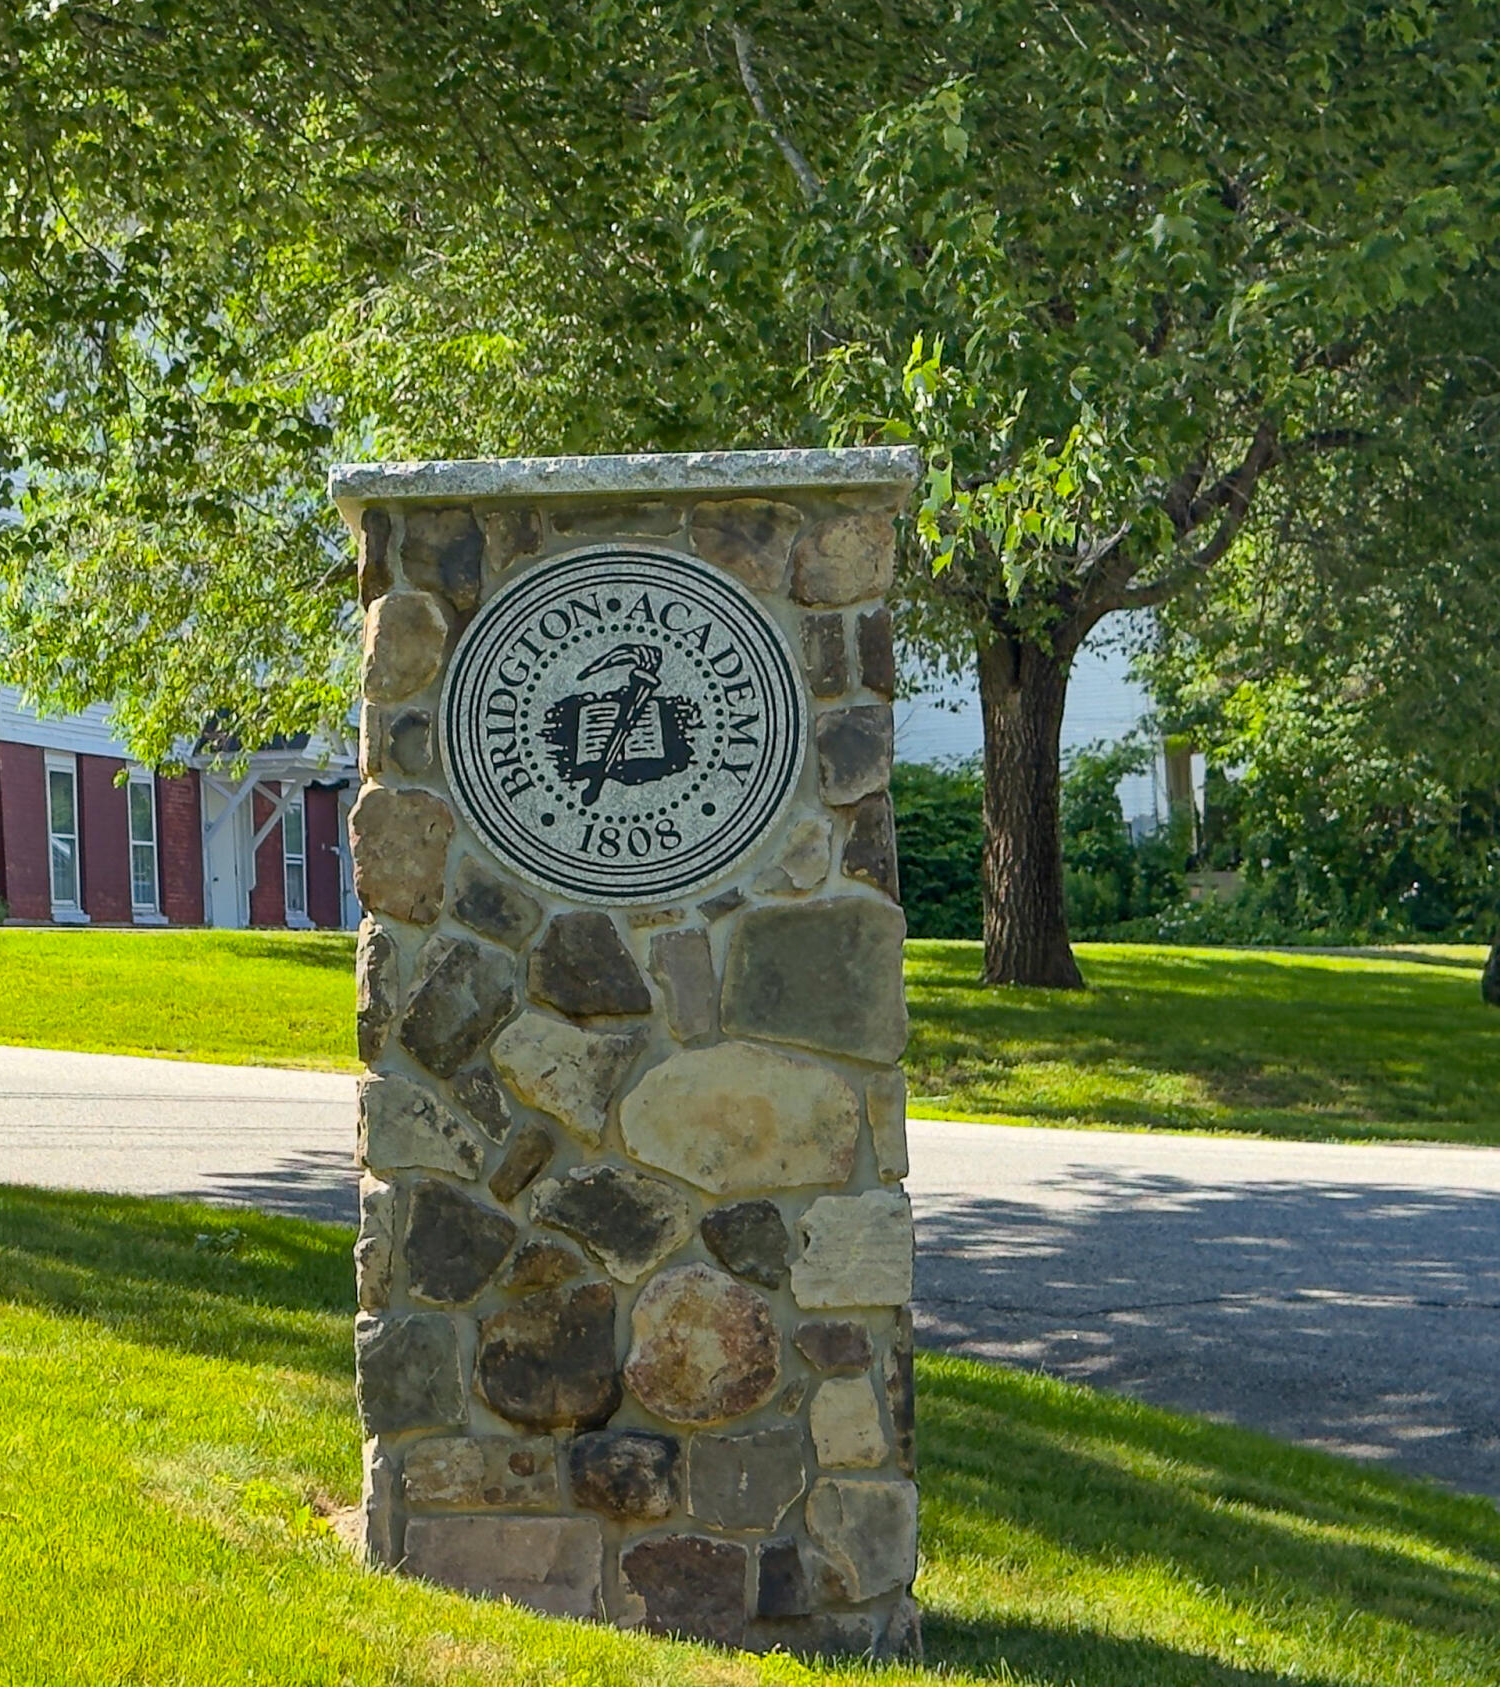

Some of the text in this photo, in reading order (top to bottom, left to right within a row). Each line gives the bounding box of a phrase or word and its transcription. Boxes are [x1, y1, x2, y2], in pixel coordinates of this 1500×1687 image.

[486, 592, 760, 801] BRIDGTON ACADEMY
[577, 818, 682, 858] 1808
